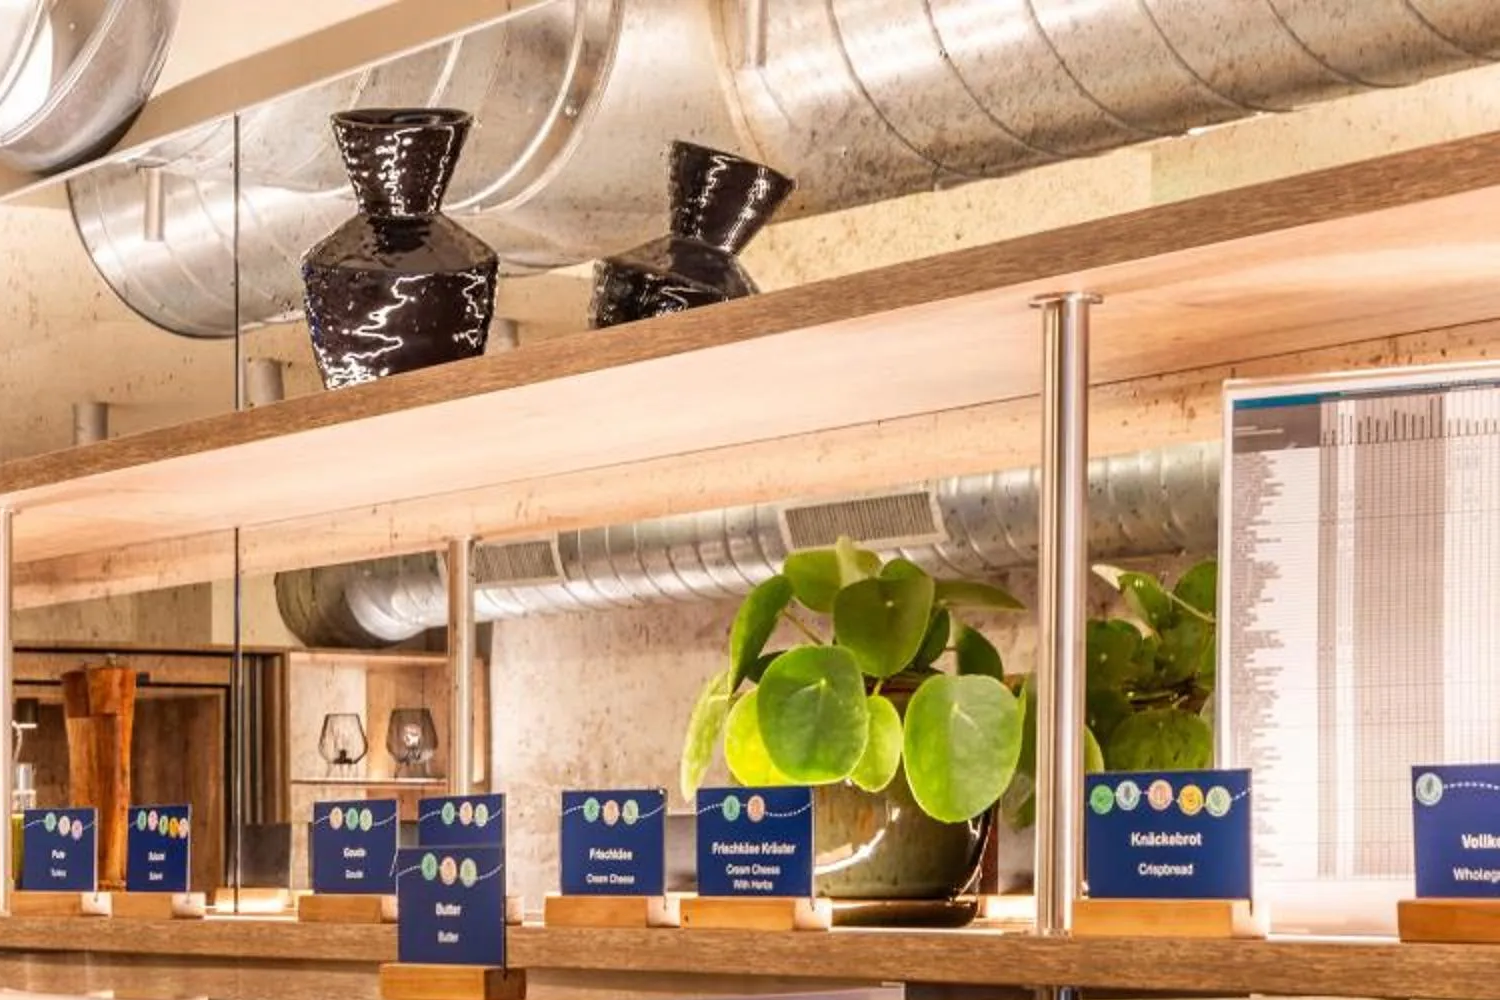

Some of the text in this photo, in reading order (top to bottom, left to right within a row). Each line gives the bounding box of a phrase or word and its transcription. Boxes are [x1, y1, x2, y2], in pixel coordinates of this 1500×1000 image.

[1130, 831, 1202, 847] Knäckebrot
[589, 847, 633, 862] Frischkäse
[711, 841, 797, 855] Frischkäse Kräuter
[1137, 862, 1194, 878] Crispbread
[435, 902, 462, 917] Butter
